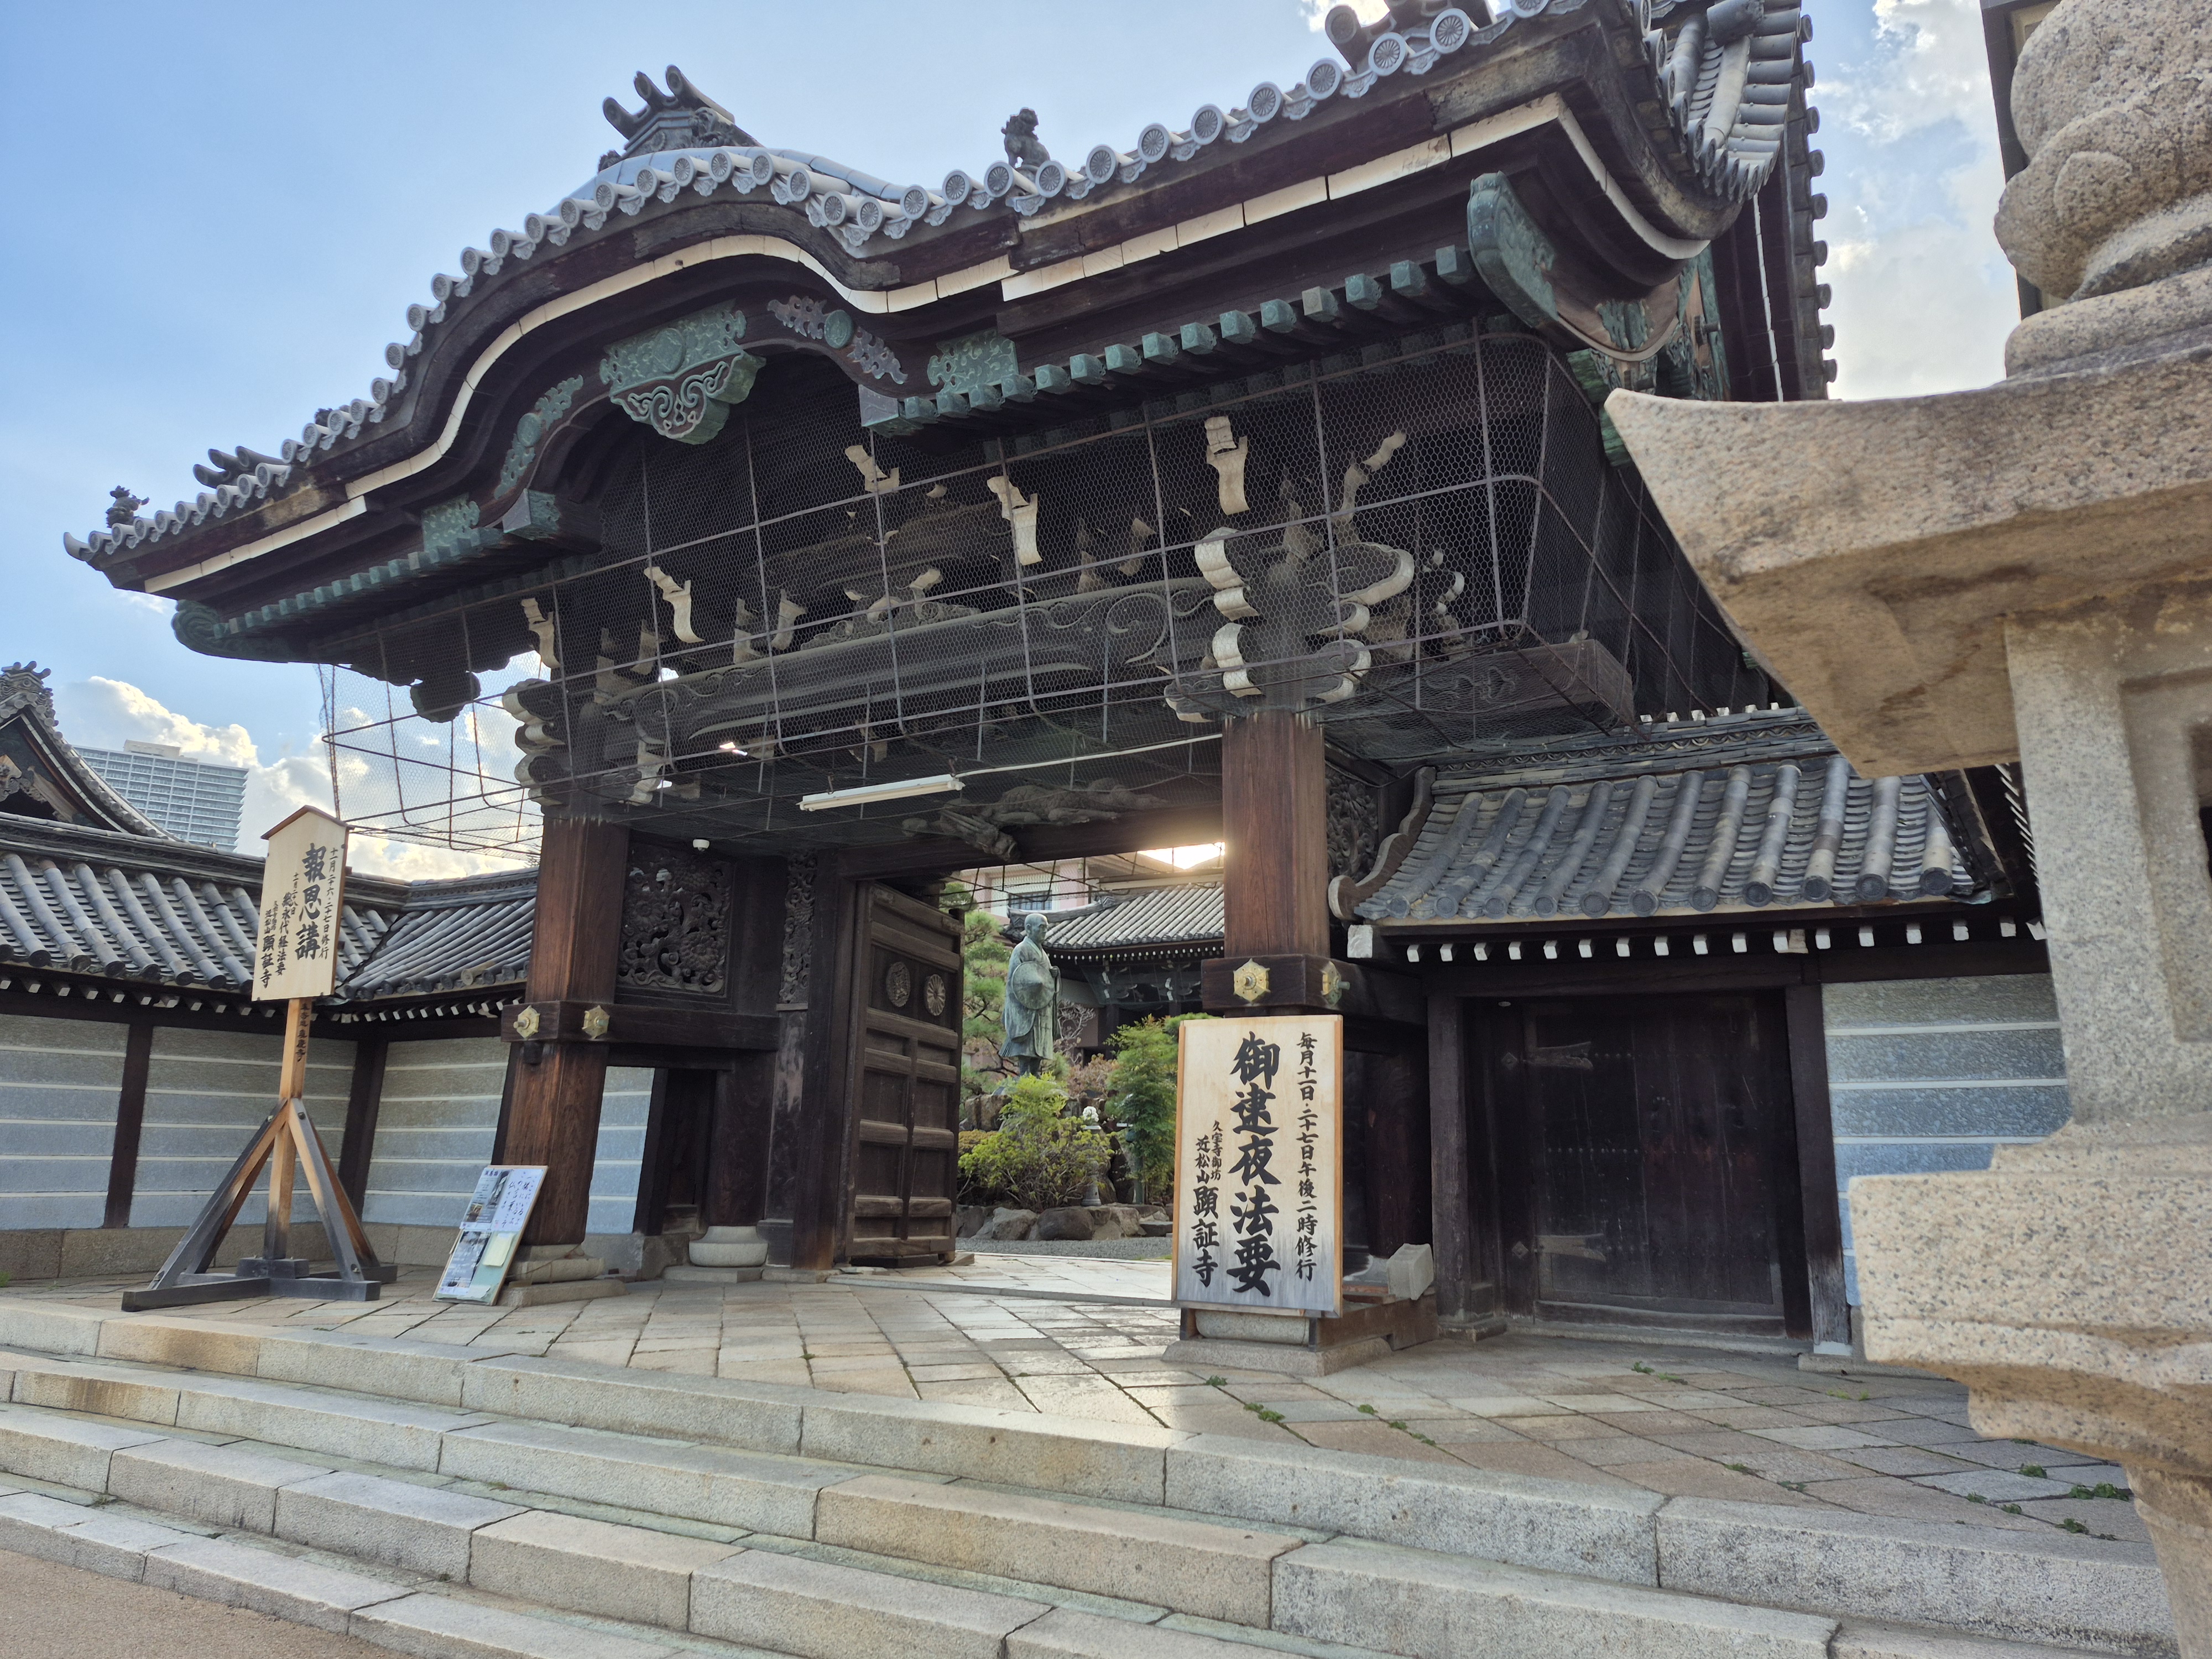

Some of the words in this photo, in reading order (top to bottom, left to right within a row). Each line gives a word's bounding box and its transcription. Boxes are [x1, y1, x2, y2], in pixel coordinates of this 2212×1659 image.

[294, 843, 327, 960] 報恩講
[1191, 1134, 1219, 1288] 近松山顕証寺
[1210, 1119, 1223, 1181] 久宝寺御坊
[1226, 1031, 1282, 1297] 御逮夜法要
[1295, 1031, 1319, 1282] 毎月十一日・二十七日午後二時修行
